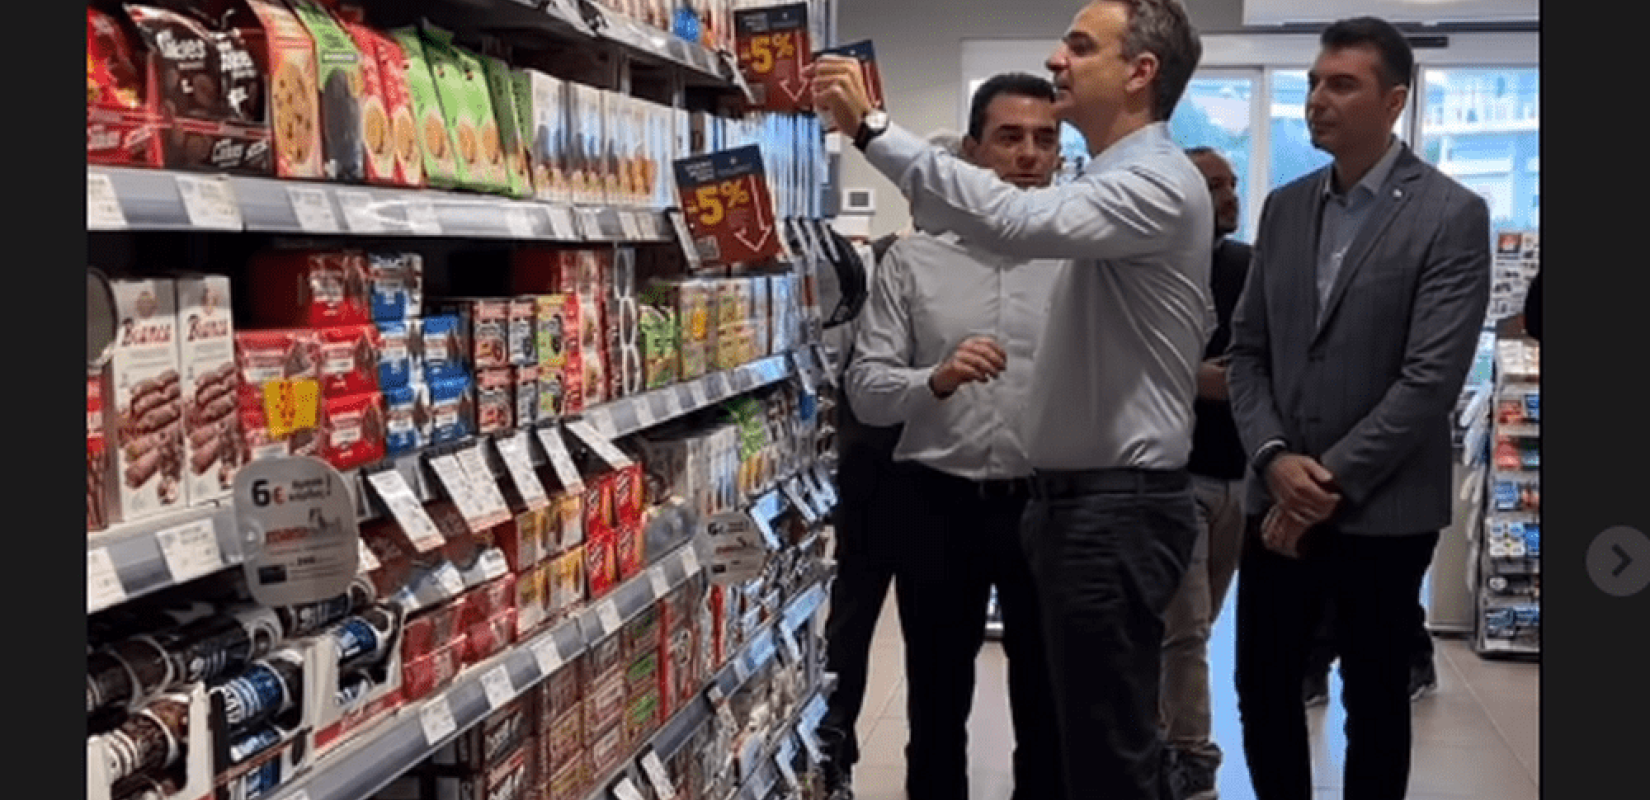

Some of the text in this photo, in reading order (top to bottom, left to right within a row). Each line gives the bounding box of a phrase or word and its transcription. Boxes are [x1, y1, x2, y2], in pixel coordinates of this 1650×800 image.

[740, 32, 796, 74] -5%
[687, 180, 750, 225] -5%
[251, 477, 286, 507] 6€
